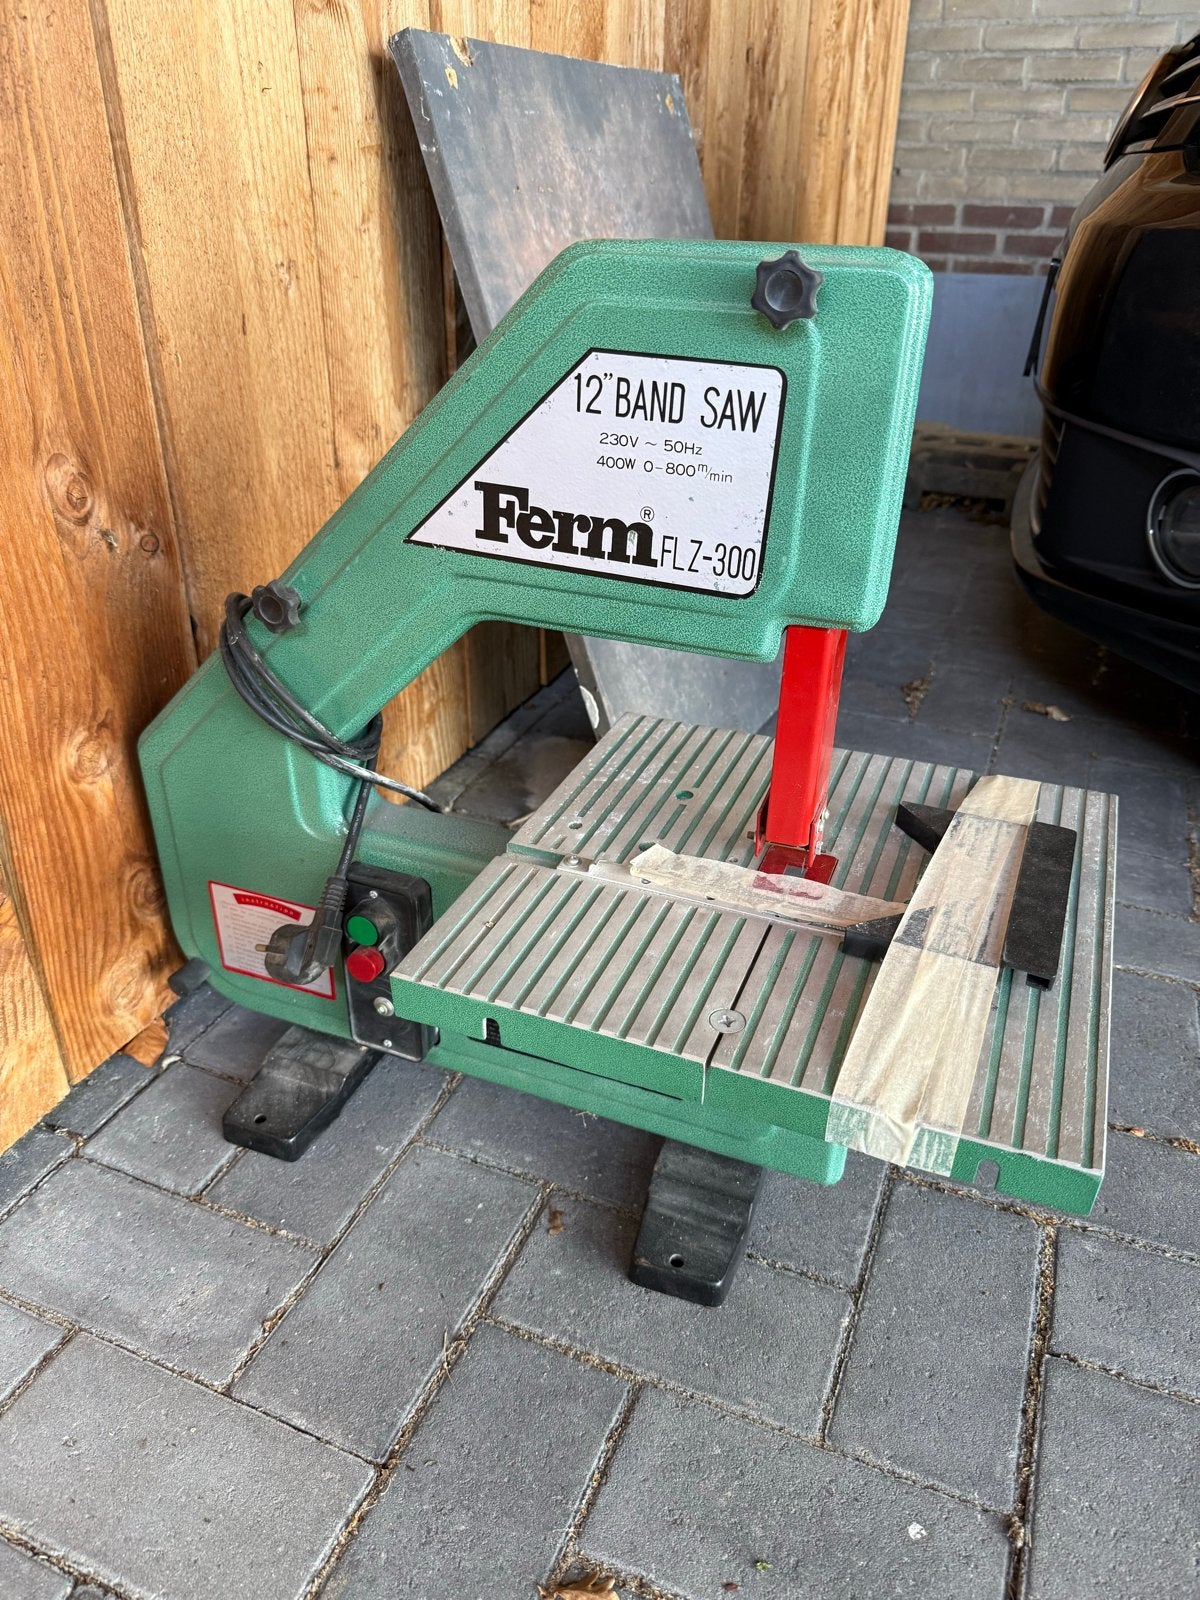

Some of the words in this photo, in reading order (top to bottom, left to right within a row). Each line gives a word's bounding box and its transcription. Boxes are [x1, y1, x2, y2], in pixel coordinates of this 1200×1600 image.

[615, 376, 686, 424] BAND
[700, 386, 767, 433] SAW
[596, 455, 636, 470] 400W
[599, 432, 639, 448] 230V
[663, 439, 703, 456] 50Hz
[474, 480, 659, 568] Ferm
[660, 535, 756, 581] FLZ-300
